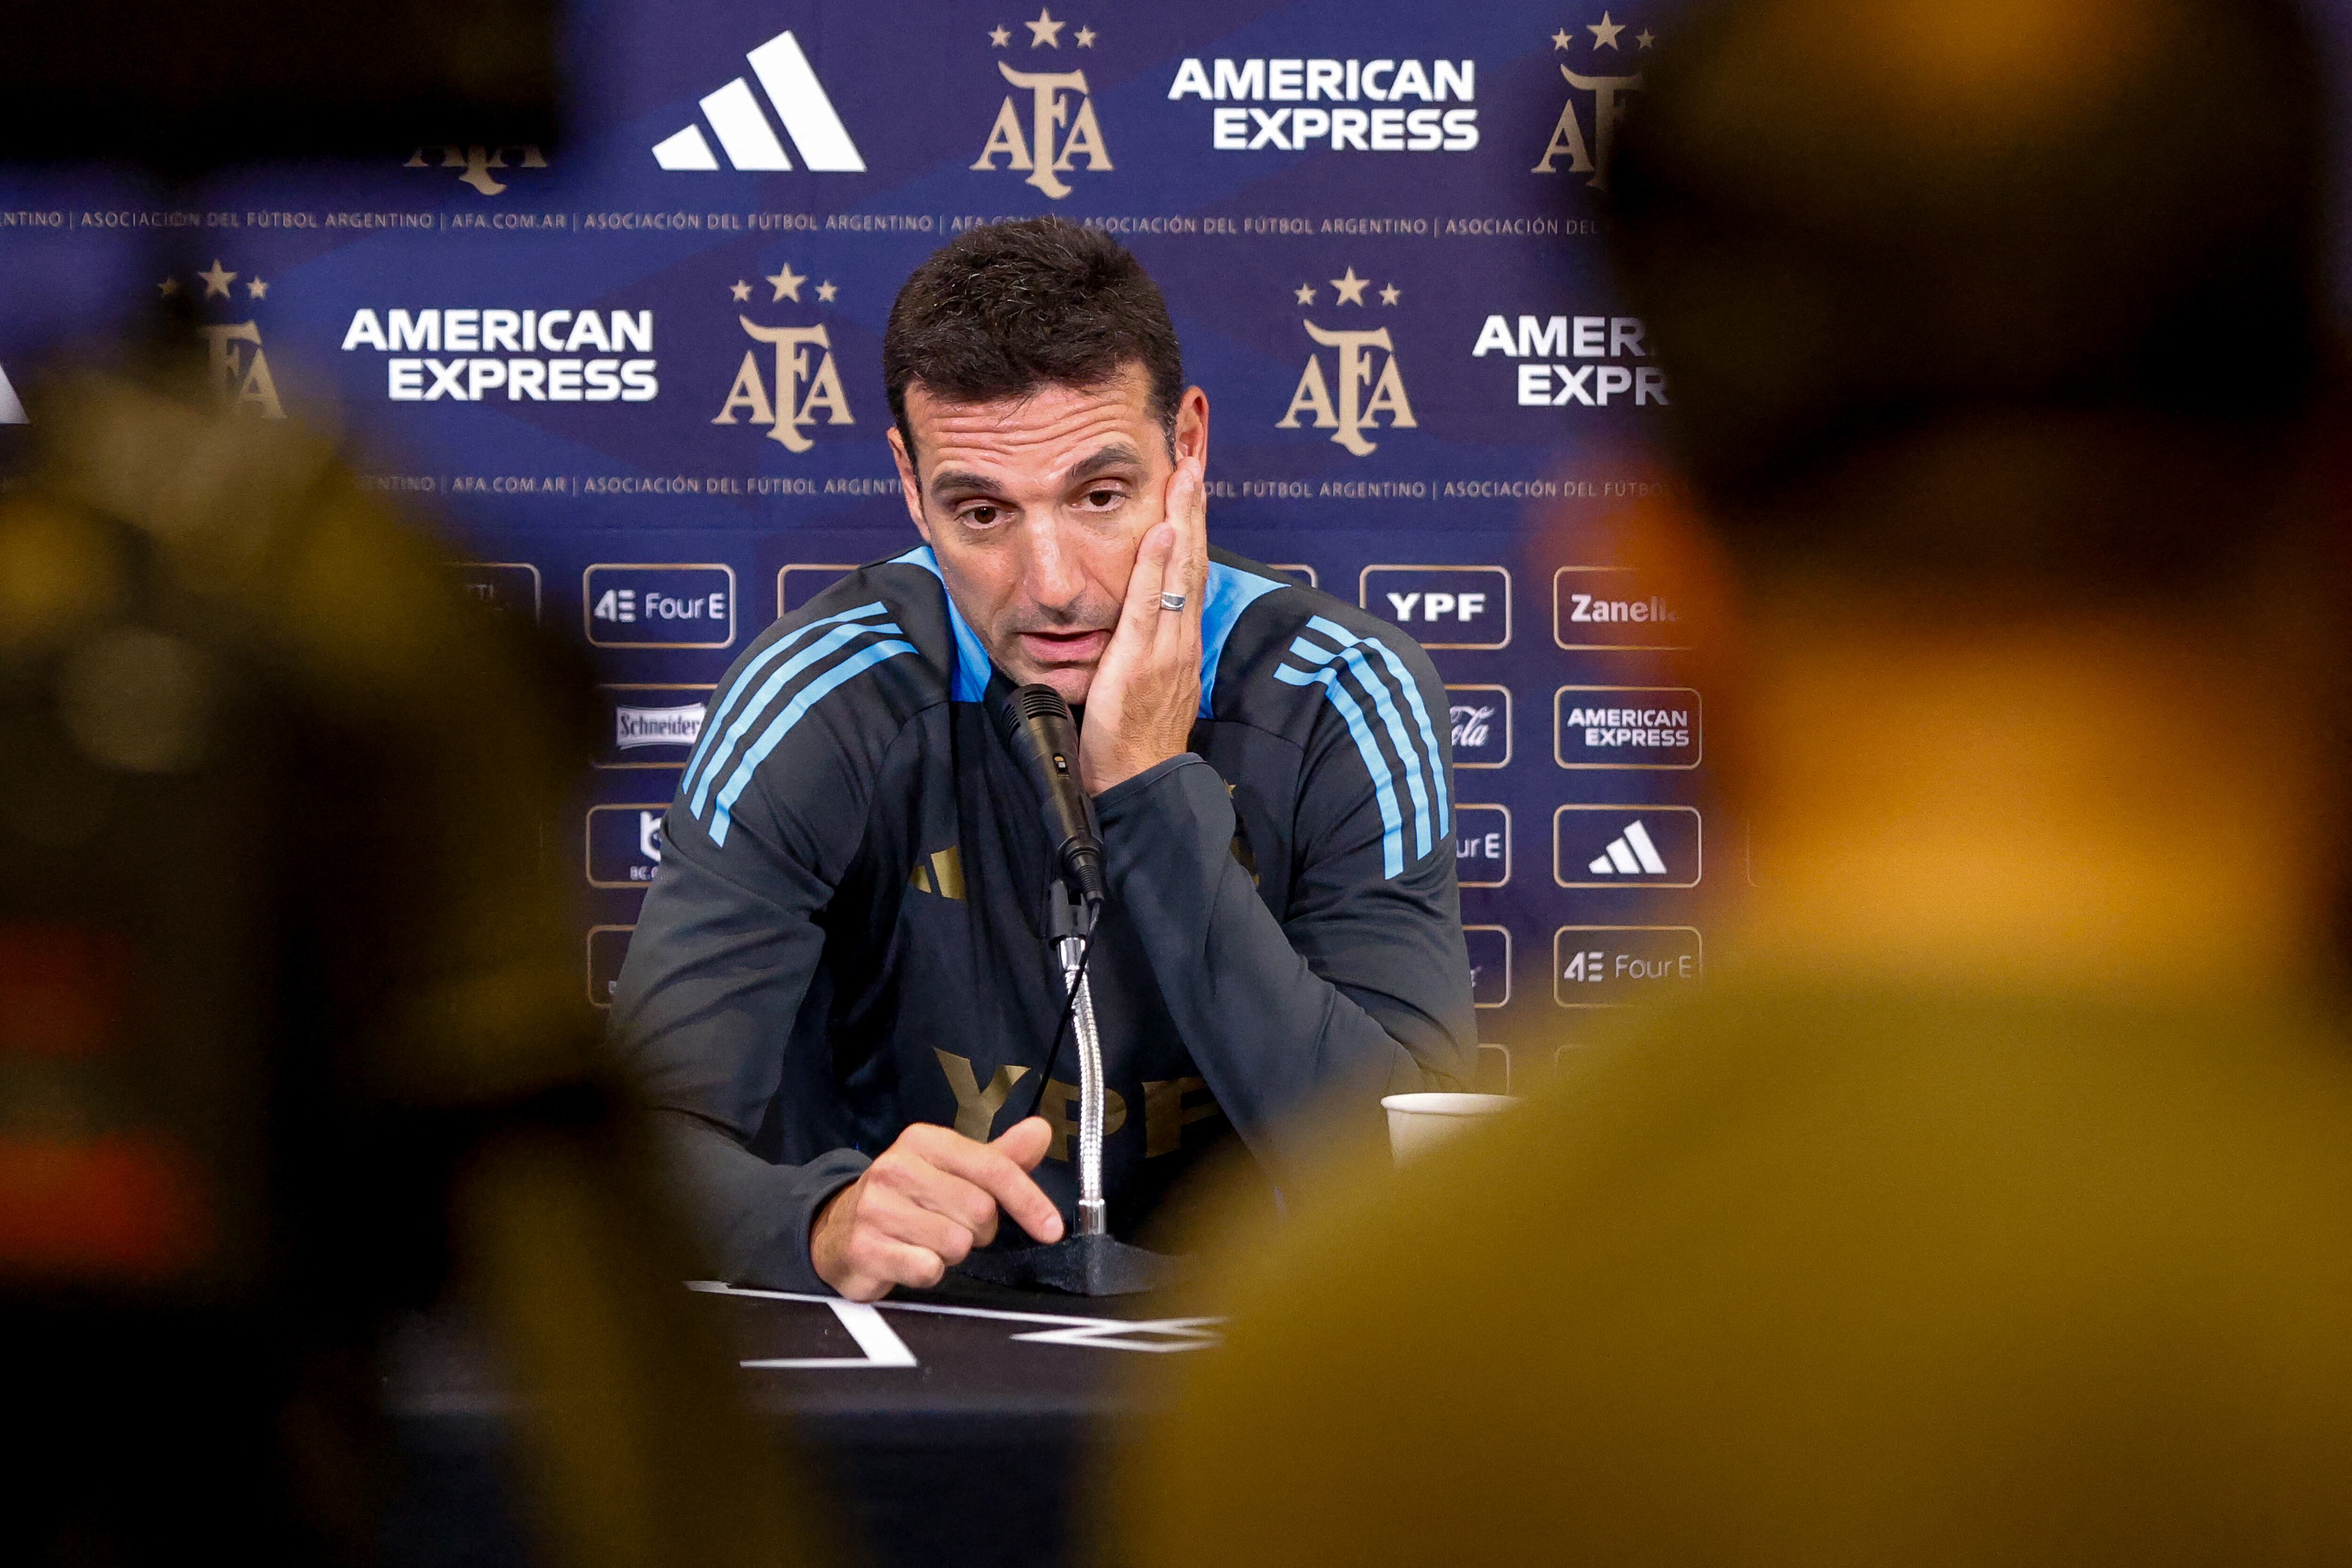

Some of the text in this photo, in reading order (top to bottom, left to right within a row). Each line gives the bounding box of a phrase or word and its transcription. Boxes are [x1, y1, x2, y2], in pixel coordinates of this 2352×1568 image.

[1167, 58, 1475, 102] AMERICAN
[1213, 108, 1479, 151] EXPRESS
[0, 211, 62, 227] NTINO
[206, 211, 240, 228] DEL
[325, 212, 433, 229] ARGENTINO
[451, 213, 565, 229] AFA.COM.AR
[584, 210, 700, 230] ASOCIACIÓN
[707, 213, 740, 230] DEL
[748, 211, 818, 231] FÚTBOL
[825, 214, 934, 231] ARGENTINO
[1203, 217, 1236, 234] DEL
[1244, 215, 1315, 234] FÚTBOL
[1320, 218, 1427, 235] ARGENTINO
[1445, 217, 1558, 235] ASOCIACIÓN
[1566, 218, 1598, 235] DEL
[341, 309, 654, 352] AMERICAN
[1472, 315, 1647, 358] AMER
[388, 358, 659, 401] EXPRESS
[1518, 364, 1671, 406] EXPR
[363, 475, 436, 492] NTINO
[452, 477, 565, 493] AFA.COM.AR
[584, 475, 699, 494] ASOCIACIÓN
[706, 477, 739, 495] DEL
[824, 478, 903, 495] ARGENTI
[1205, 481, 1236, 499] DEL
[1319, 481, 1426, 500] ARGENTINO
[1443, 478, 1557, 498] ASOCIACIÓN
[1564, 481, 1597, 498] DEL
[645, 592, 705, 620] Four
[1386, 592, 1486, 622] YPF
[620, 712, 701, 738] Schneider
[1567, 708, 1688, 727] AMERICAN
[1585, 727, 1690, 747] EXPRESS
[1614, 954, 1673, 979] Four
